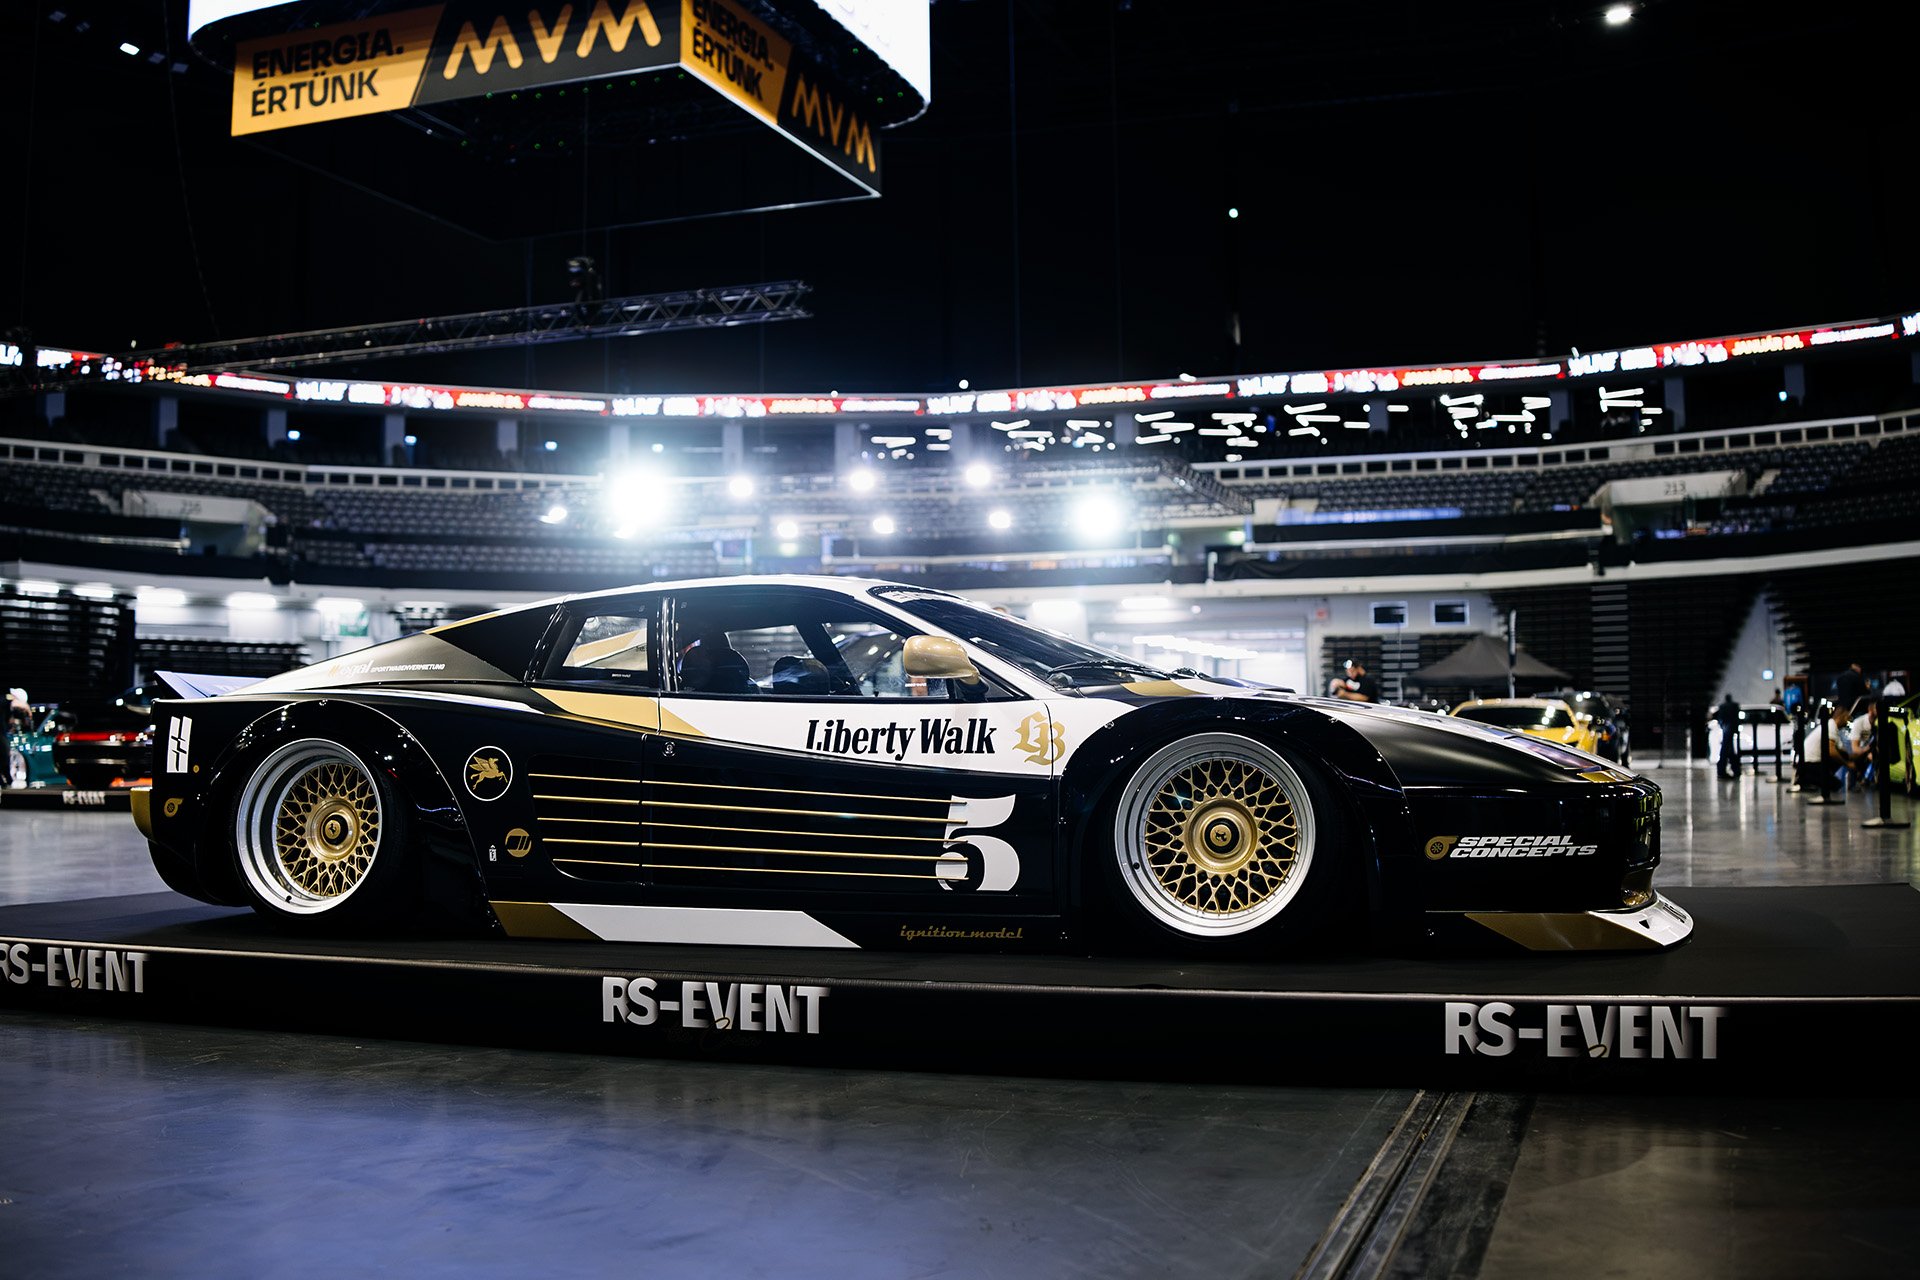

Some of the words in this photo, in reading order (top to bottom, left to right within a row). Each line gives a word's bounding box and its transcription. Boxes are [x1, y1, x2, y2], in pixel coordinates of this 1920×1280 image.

[252, 28, 404, 80] ENERGIA.
[443, 0, 662, 80] MVM
[692, 21, 763, 102] ÉRTÜNK
[693, 0, 774, 71] ENERGIA.
[251, 67, 379, 117] ÉRTÜNK
[791, 72, 876, 173] MVM
[805, 719, 916, 761] Liberty
[919, 718, 998, 754] Walk
[935, 794, 1020, 891] 5
[1450, 845, 1598, 858] CONCEPTS
[1457, 835, 1573, 847] SPECIAL
[900, 925, 969, 941] ignition
[970, 927, 1024, 939] model
[602, 976, 831, 1035] RS-EVENT
[1444, 1002, 1730, 1060] RS-EVENT
